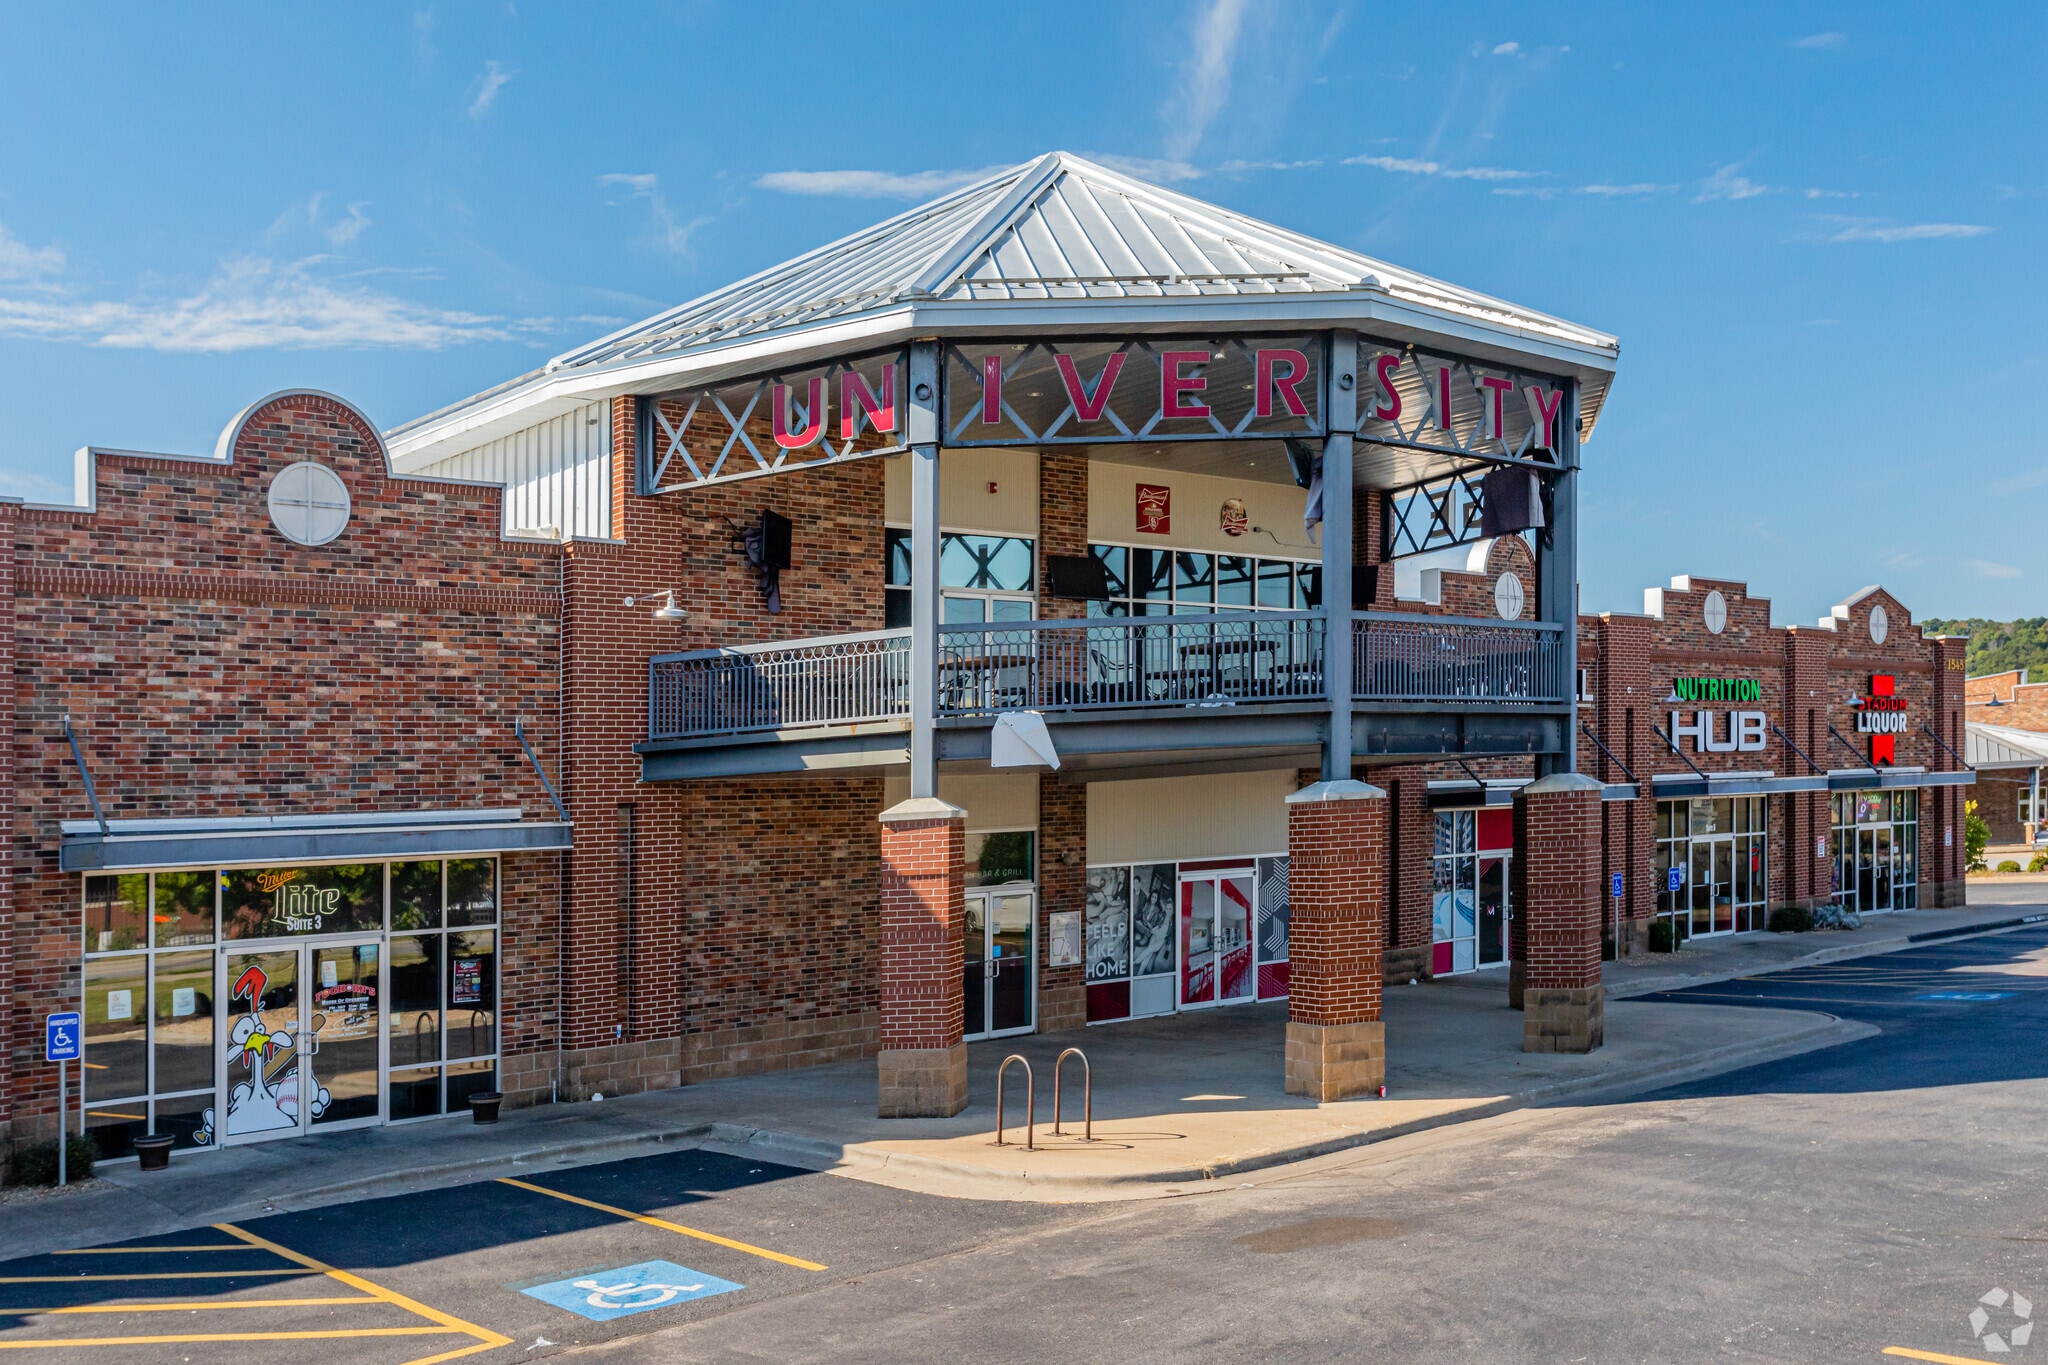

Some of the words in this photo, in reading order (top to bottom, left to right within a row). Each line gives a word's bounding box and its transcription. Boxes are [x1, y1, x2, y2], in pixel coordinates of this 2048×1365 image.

[1947, 659, 1965, 671] 1545
[1677, 677, 1761, 702] NUTRITION
[1858, 698, 1907, 711] STADIUM
[1672, 710, 1767, 753] HUB
[1857, 712, 1908, 733] LIQUOR
[257, 870, 298, 889] Miller
[994, 868, 1001, 877] &
[1002, 868, 1024, 877] GRILL
[271, 884, 340, 925] Lite
[314, 914, 322, 930] 3
[1086, 922, 1126, 940] FEELS
[1086, 943, 1115, 959] LIKE
[1086, 959, 1127, 979] HOME
[52, 1047, 75, 1055] PARKING
